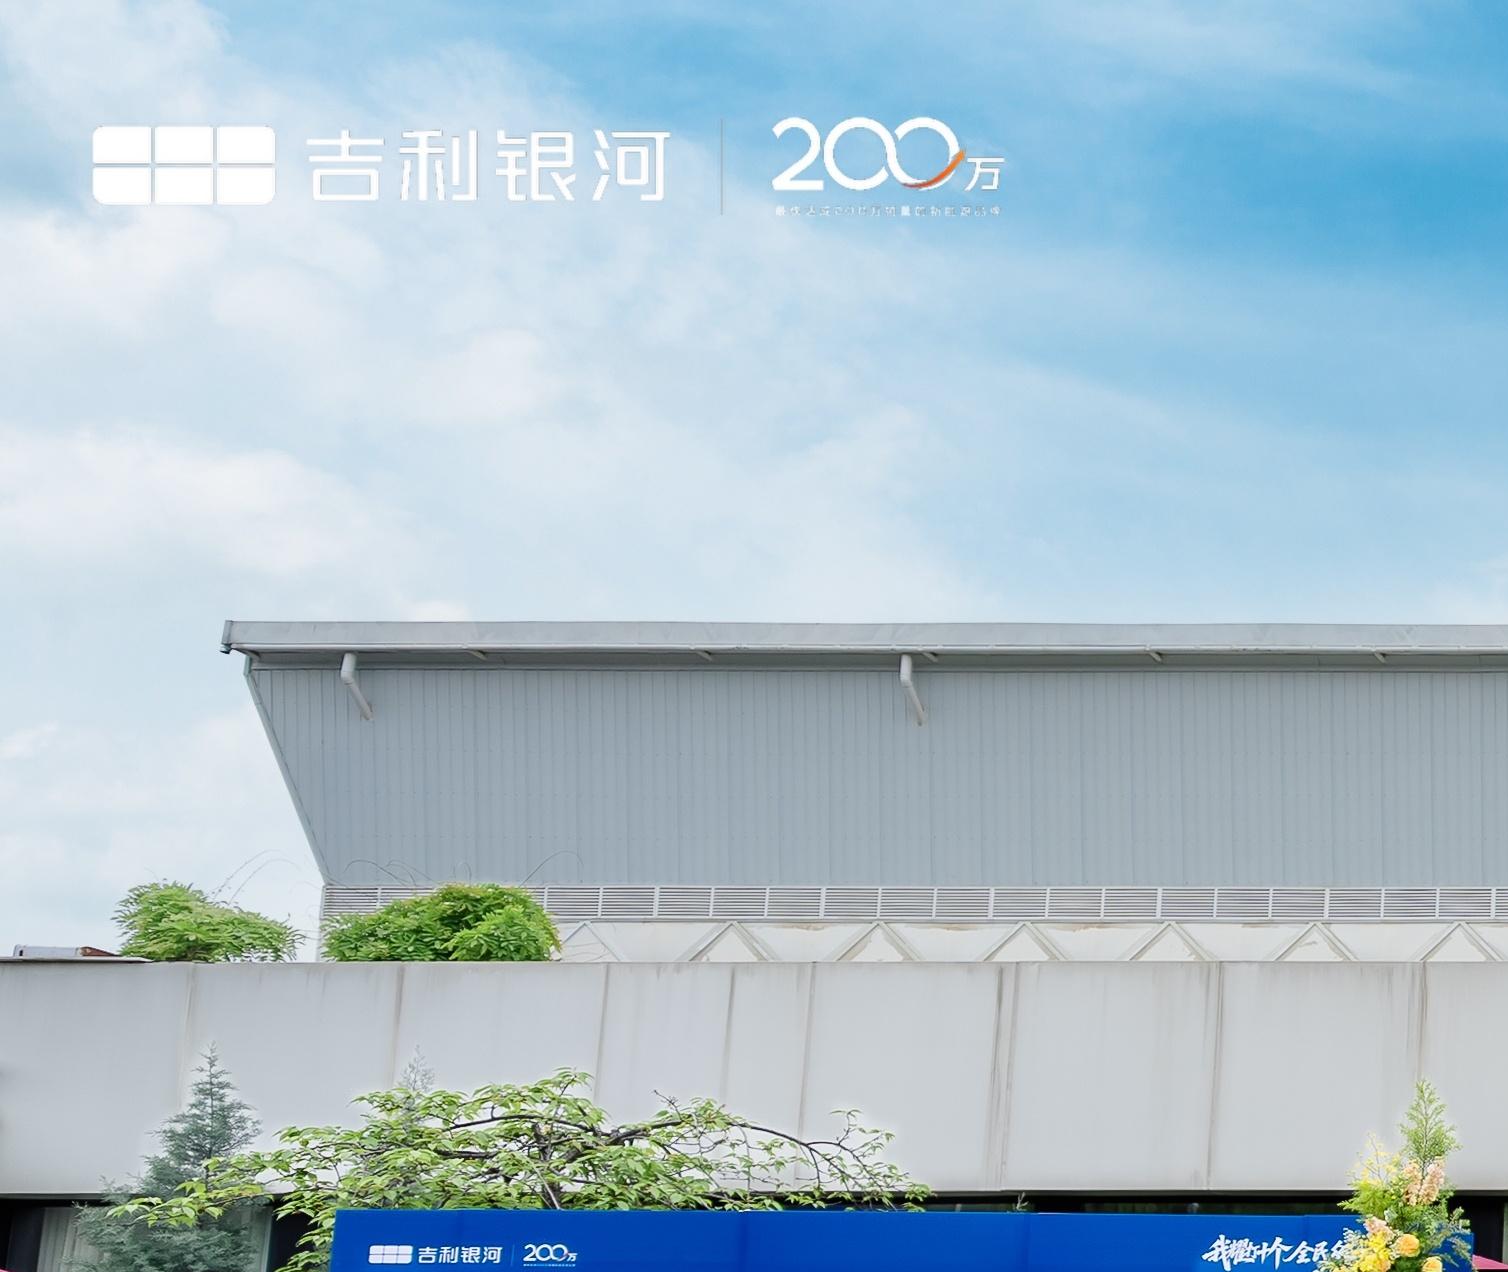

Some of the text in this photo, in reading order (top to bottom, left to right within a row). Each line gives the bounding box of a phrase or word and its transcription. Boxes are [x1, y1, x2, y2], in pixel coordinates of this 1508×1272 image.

[418, 1243, 578, 1264] 吉利银河 200万
